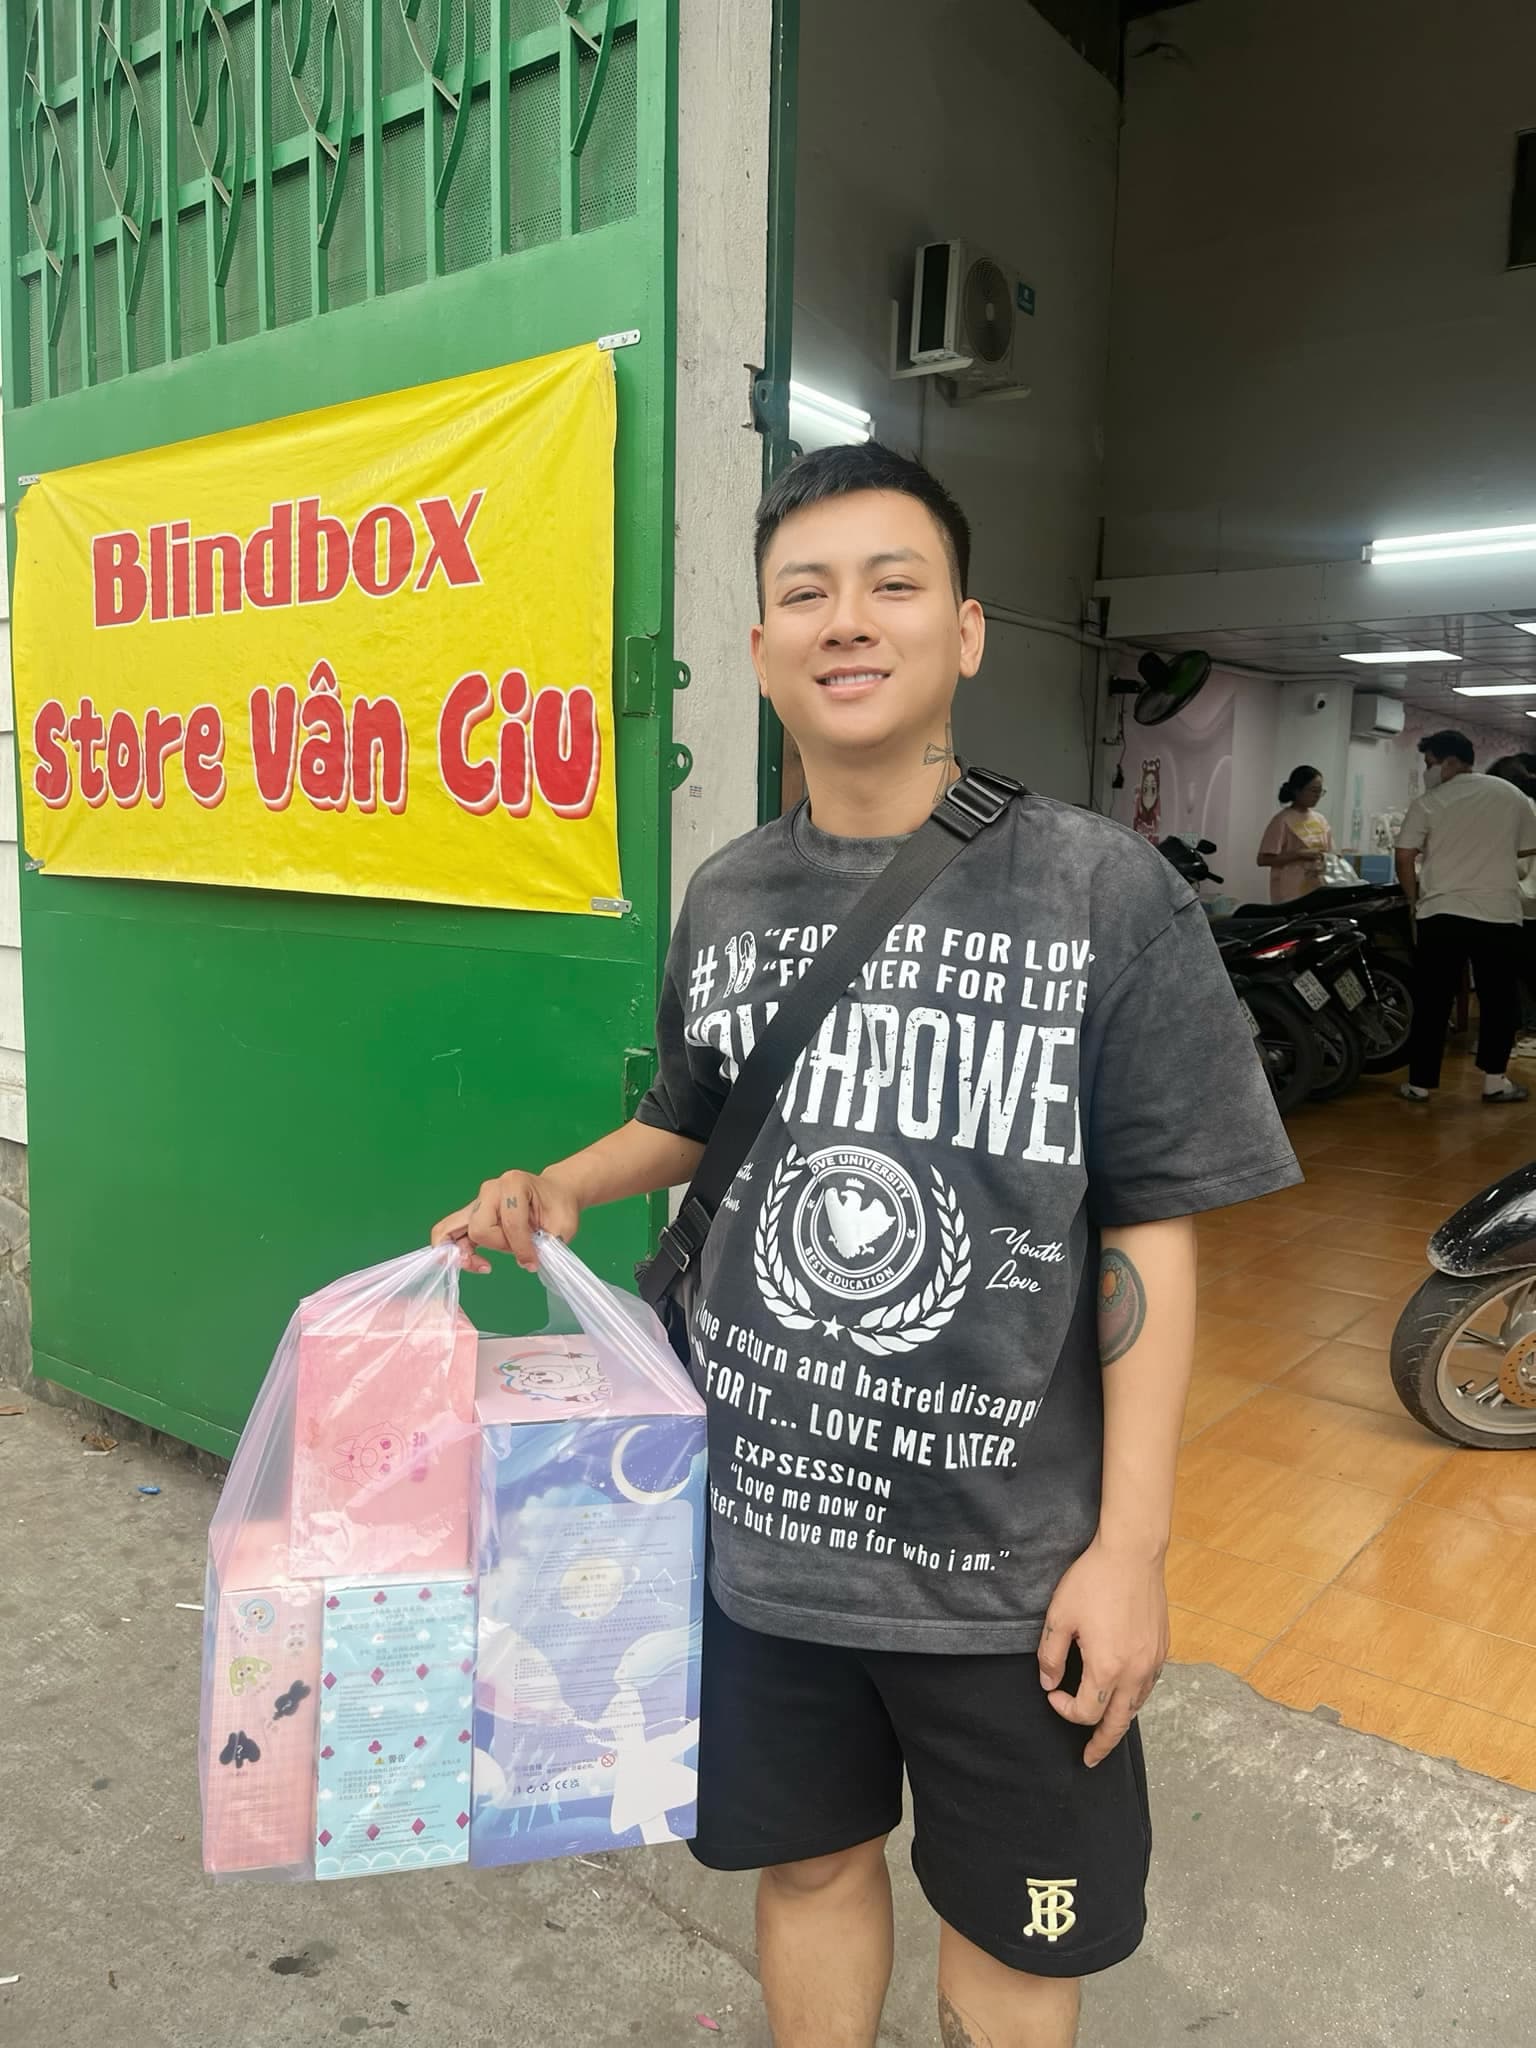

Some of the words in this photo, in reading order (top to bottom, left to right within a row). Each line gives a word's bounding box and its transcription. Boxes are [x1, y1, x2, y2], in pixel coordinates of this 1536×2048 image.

[92, 489, 487, 630] Blindbox
[249, 658, 409, 815] Vân
[941, 927, 1012, 964] FOR
[1025, 939, 1097, 972] LOV
[936, 963, 1007, 1004] FOR
[838, 1154, 911, 1198] UNIVERSITY
[990, 1227, 1066, 1262] Youth
[805, 1246, 827, 1271] BEST
[826, 1266, 895, 1290] EDUCATION
[985, 1259, 1042, 1293] Love
[726, 1324, 788, 1373] return
[797, 1356, 846, 1391] and
[855, 1364, 945, 1414] hatred
[706, 1360, 745, 1408] FOR
[809, 1403, 882, 1452] LOVE
[892, 1425, 937, 1467] ME
[944, 1432, 1017, 1470] LATER.
[734, 1435, 892, 1499] EXPSESSION
[781, 1487, 811, 1512] me
[818, 1494, 859, 1518] now
[865, 1503, 887, 1524] or
[744, 1502, 774, 1536] but
[780, 1513, 822, 1545] love
[829, 1527, 858, 1550] me
[866, 1528, 897, 1555] for
[903, 1542, 940, 1570] who
[948, 1549, 956, 1572] i
